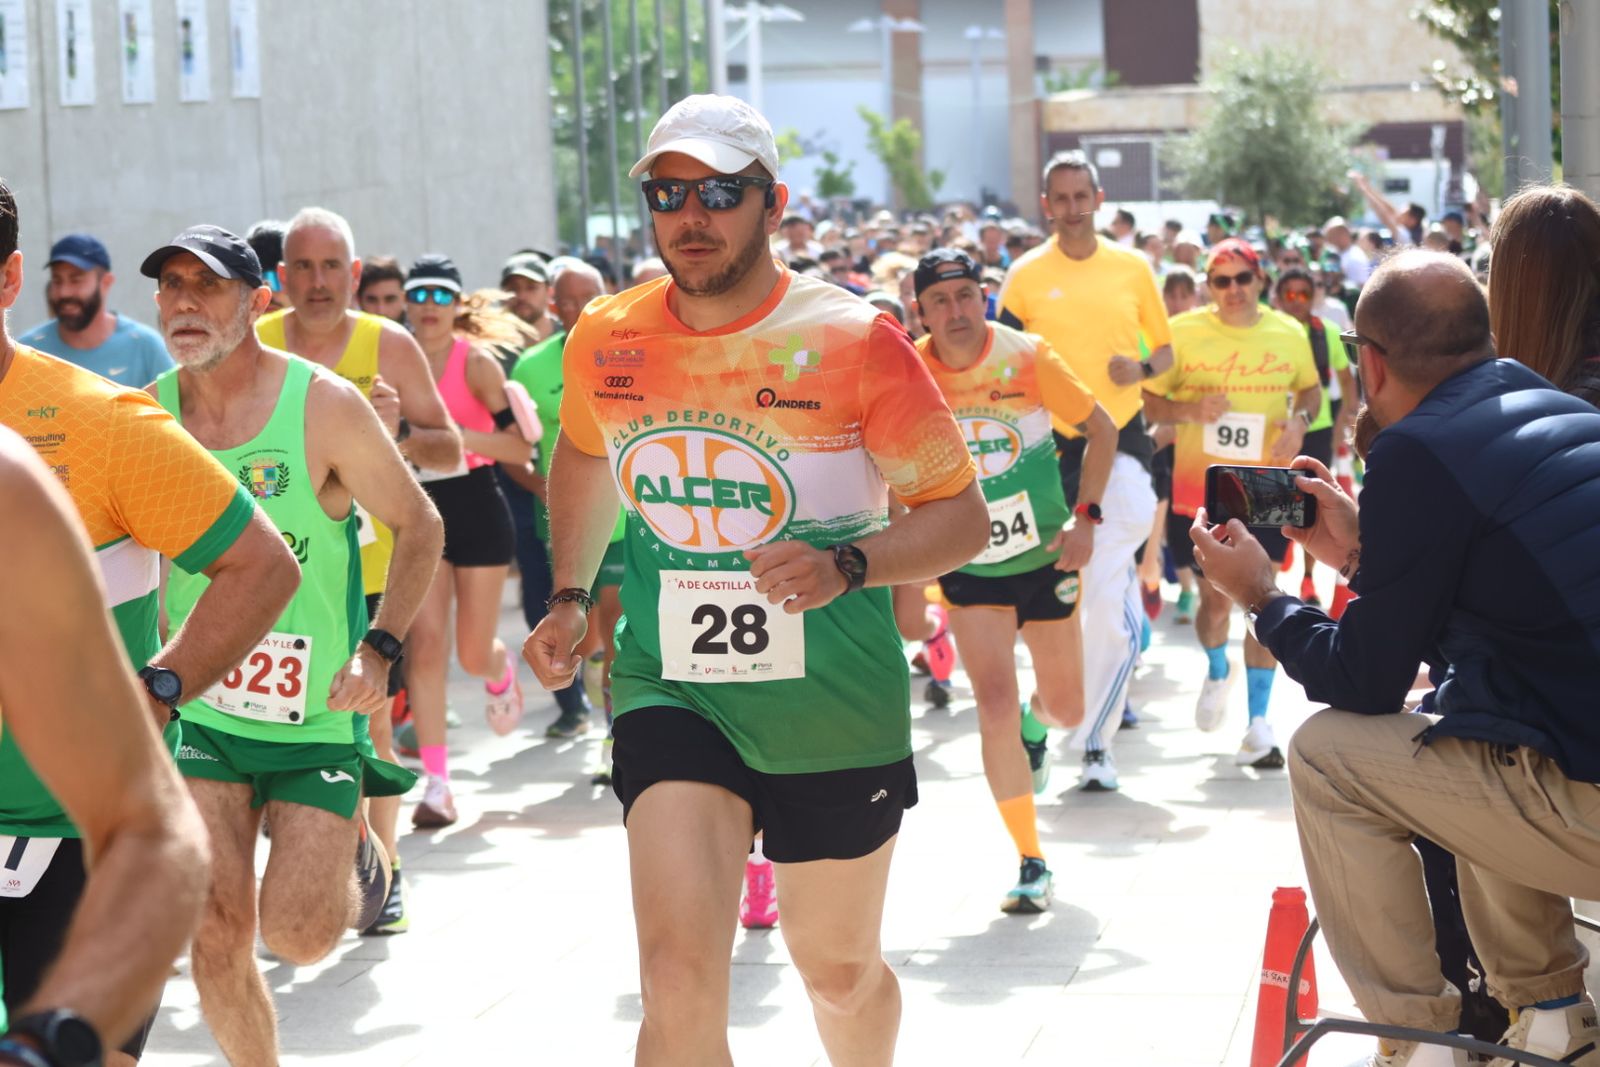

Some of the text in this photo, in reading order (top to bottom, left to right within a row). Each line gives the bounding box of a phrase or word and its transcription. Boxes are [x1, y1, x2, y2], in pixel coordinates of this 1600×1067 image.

[594, 390, 644, 401] Helmántica
[613, 410, 790, 462] CLUB DEPORTIVO
[1217, 425, 1249, 447] 98
[634, 474, 776, 516] ALCER
[987, 511, 1029, 549] 94
[688, 581, 700, 590] DE
[703, 581, 751, 590] CASTILLA
[691, 604, 769, 655] 28
